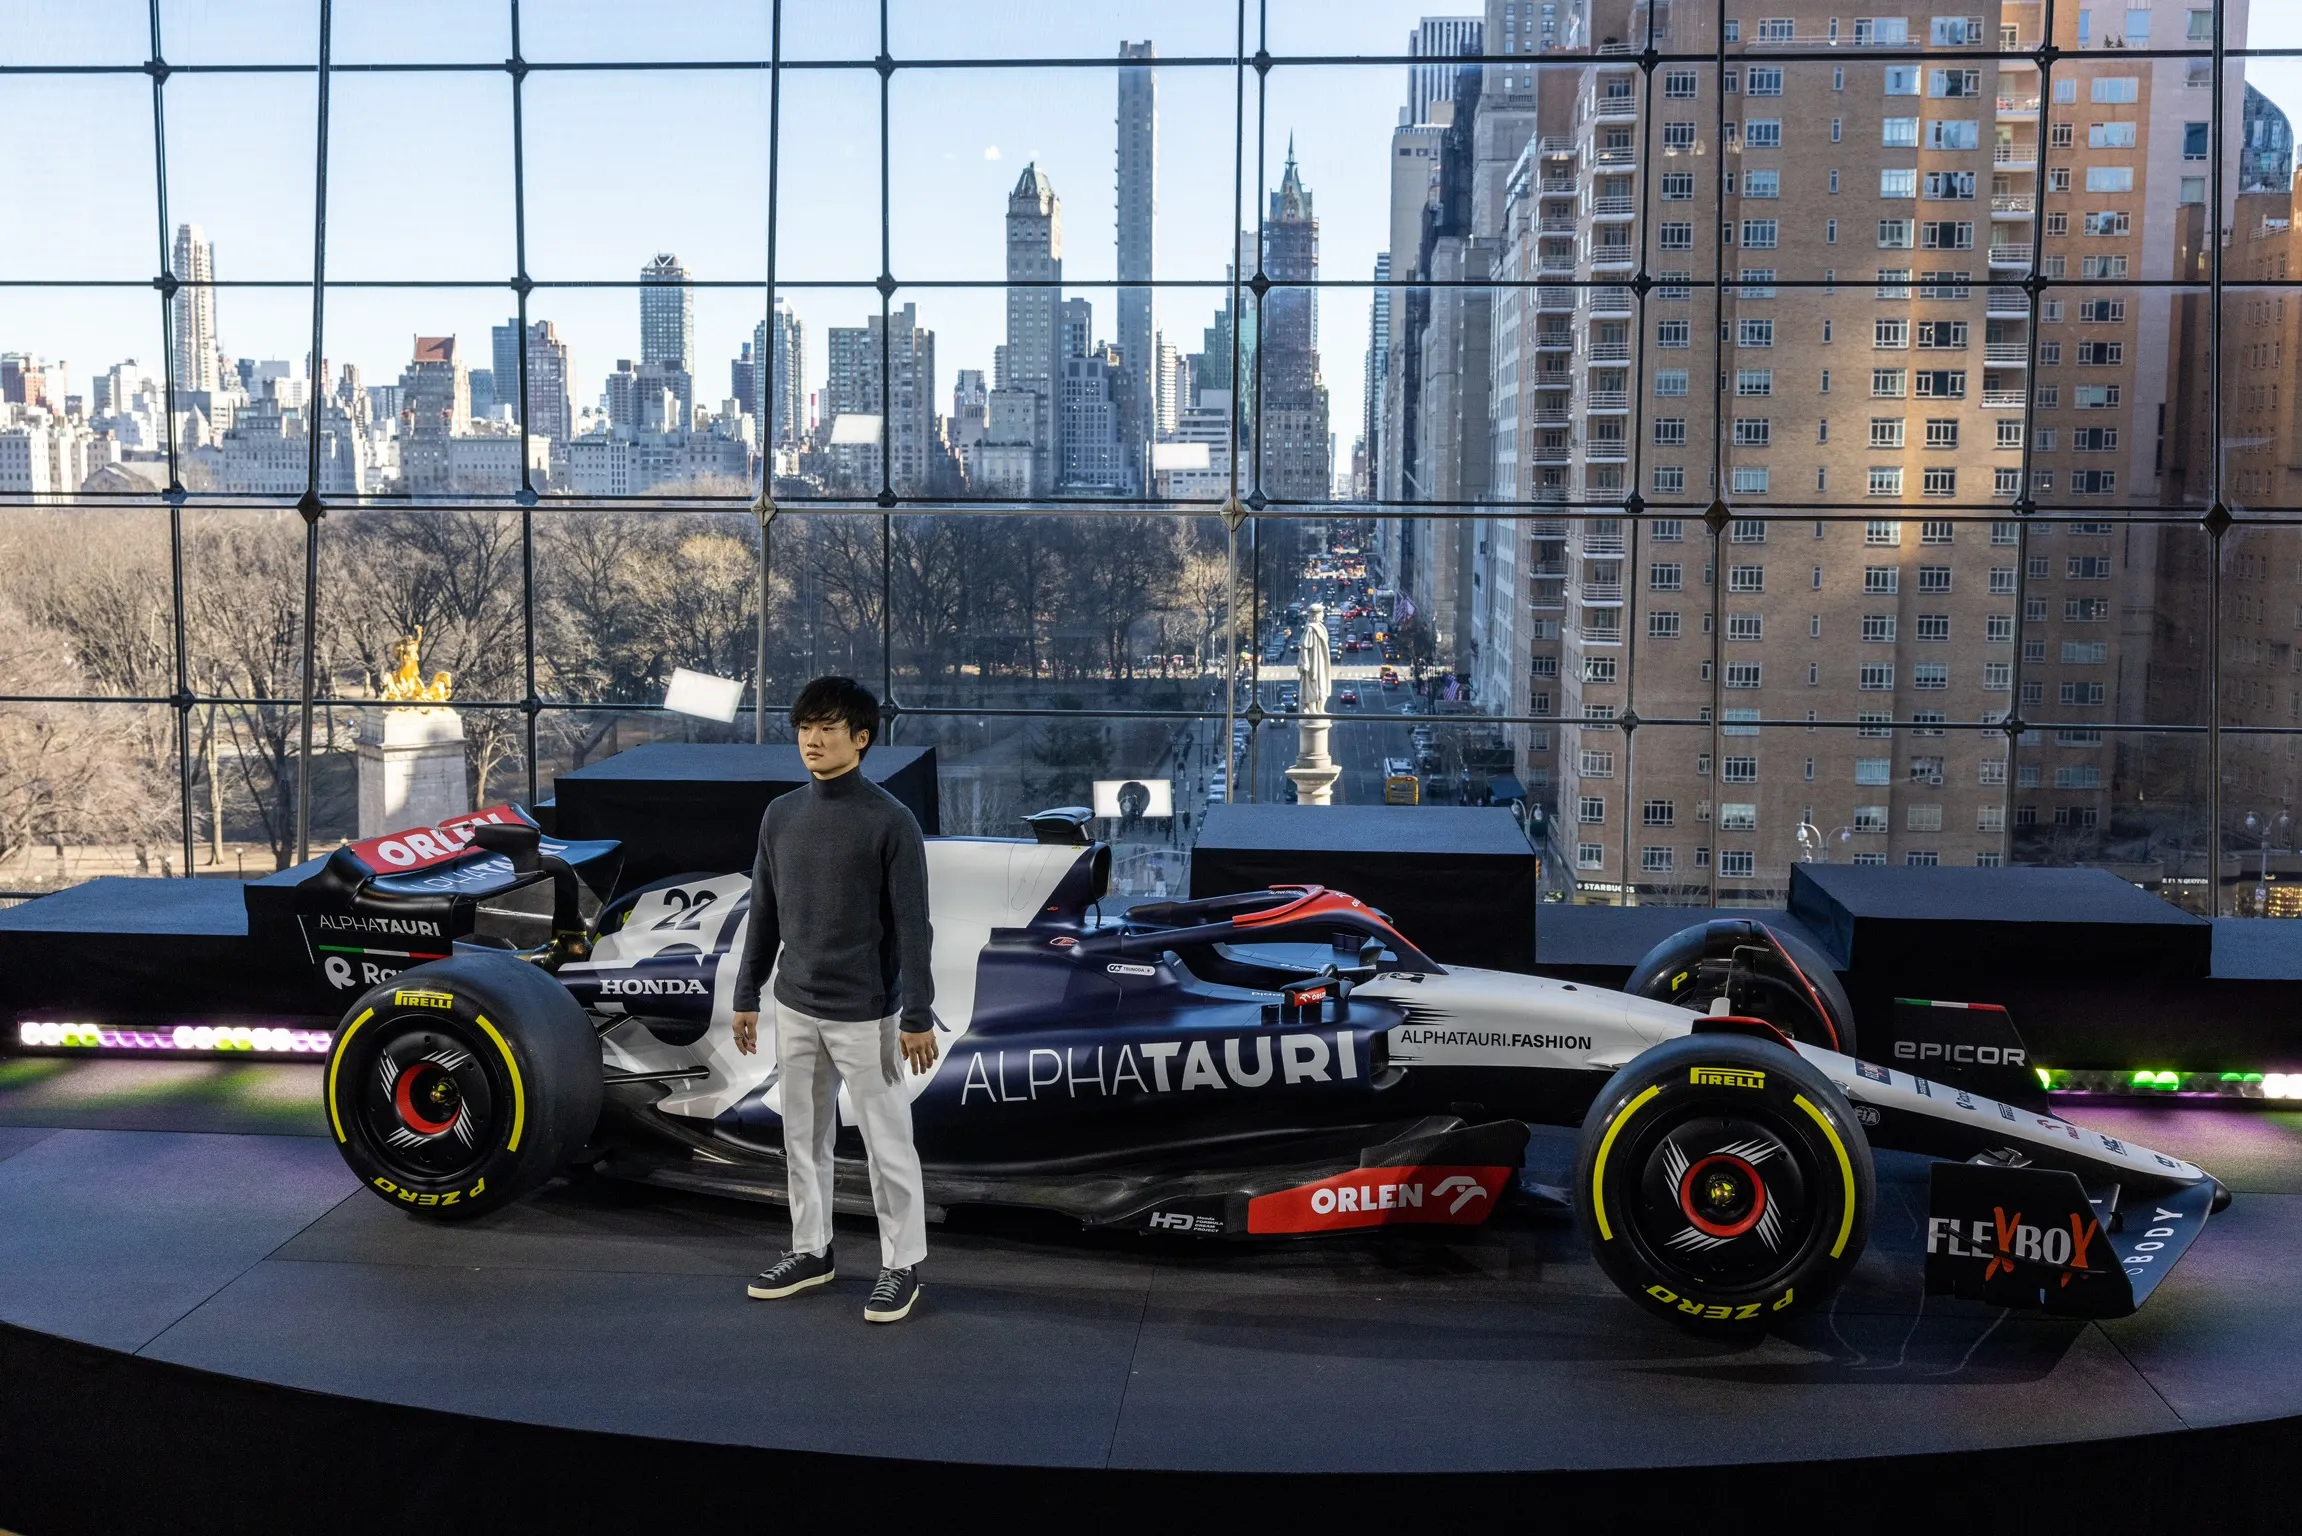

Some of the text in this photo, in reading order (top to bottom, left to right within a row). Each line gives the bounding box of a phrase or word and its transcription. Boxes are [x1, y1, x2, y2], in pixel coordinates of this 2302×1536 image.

[650, 888, 718, 930] 22
[320, 914, 441, 936] ALPHATAURI
[600, 979, 708, 995] HONDA
[1672, 971, 1688, 991] P
[394, 990, 454, 1009] PIRELLI
[1401, 1030, 1591, 1050] ALPHATAURI.FASHION
[961, 1031, 1358, 1106] ALPHATAURI
[1689, 1067, 1766, 1089] PIRELLI
[373, 1177, 485, 1206] P ZERO
[1310, 1183, 1424, 1215] ORLEN
[1646, 1285, 1793, 1320] P ZERO
